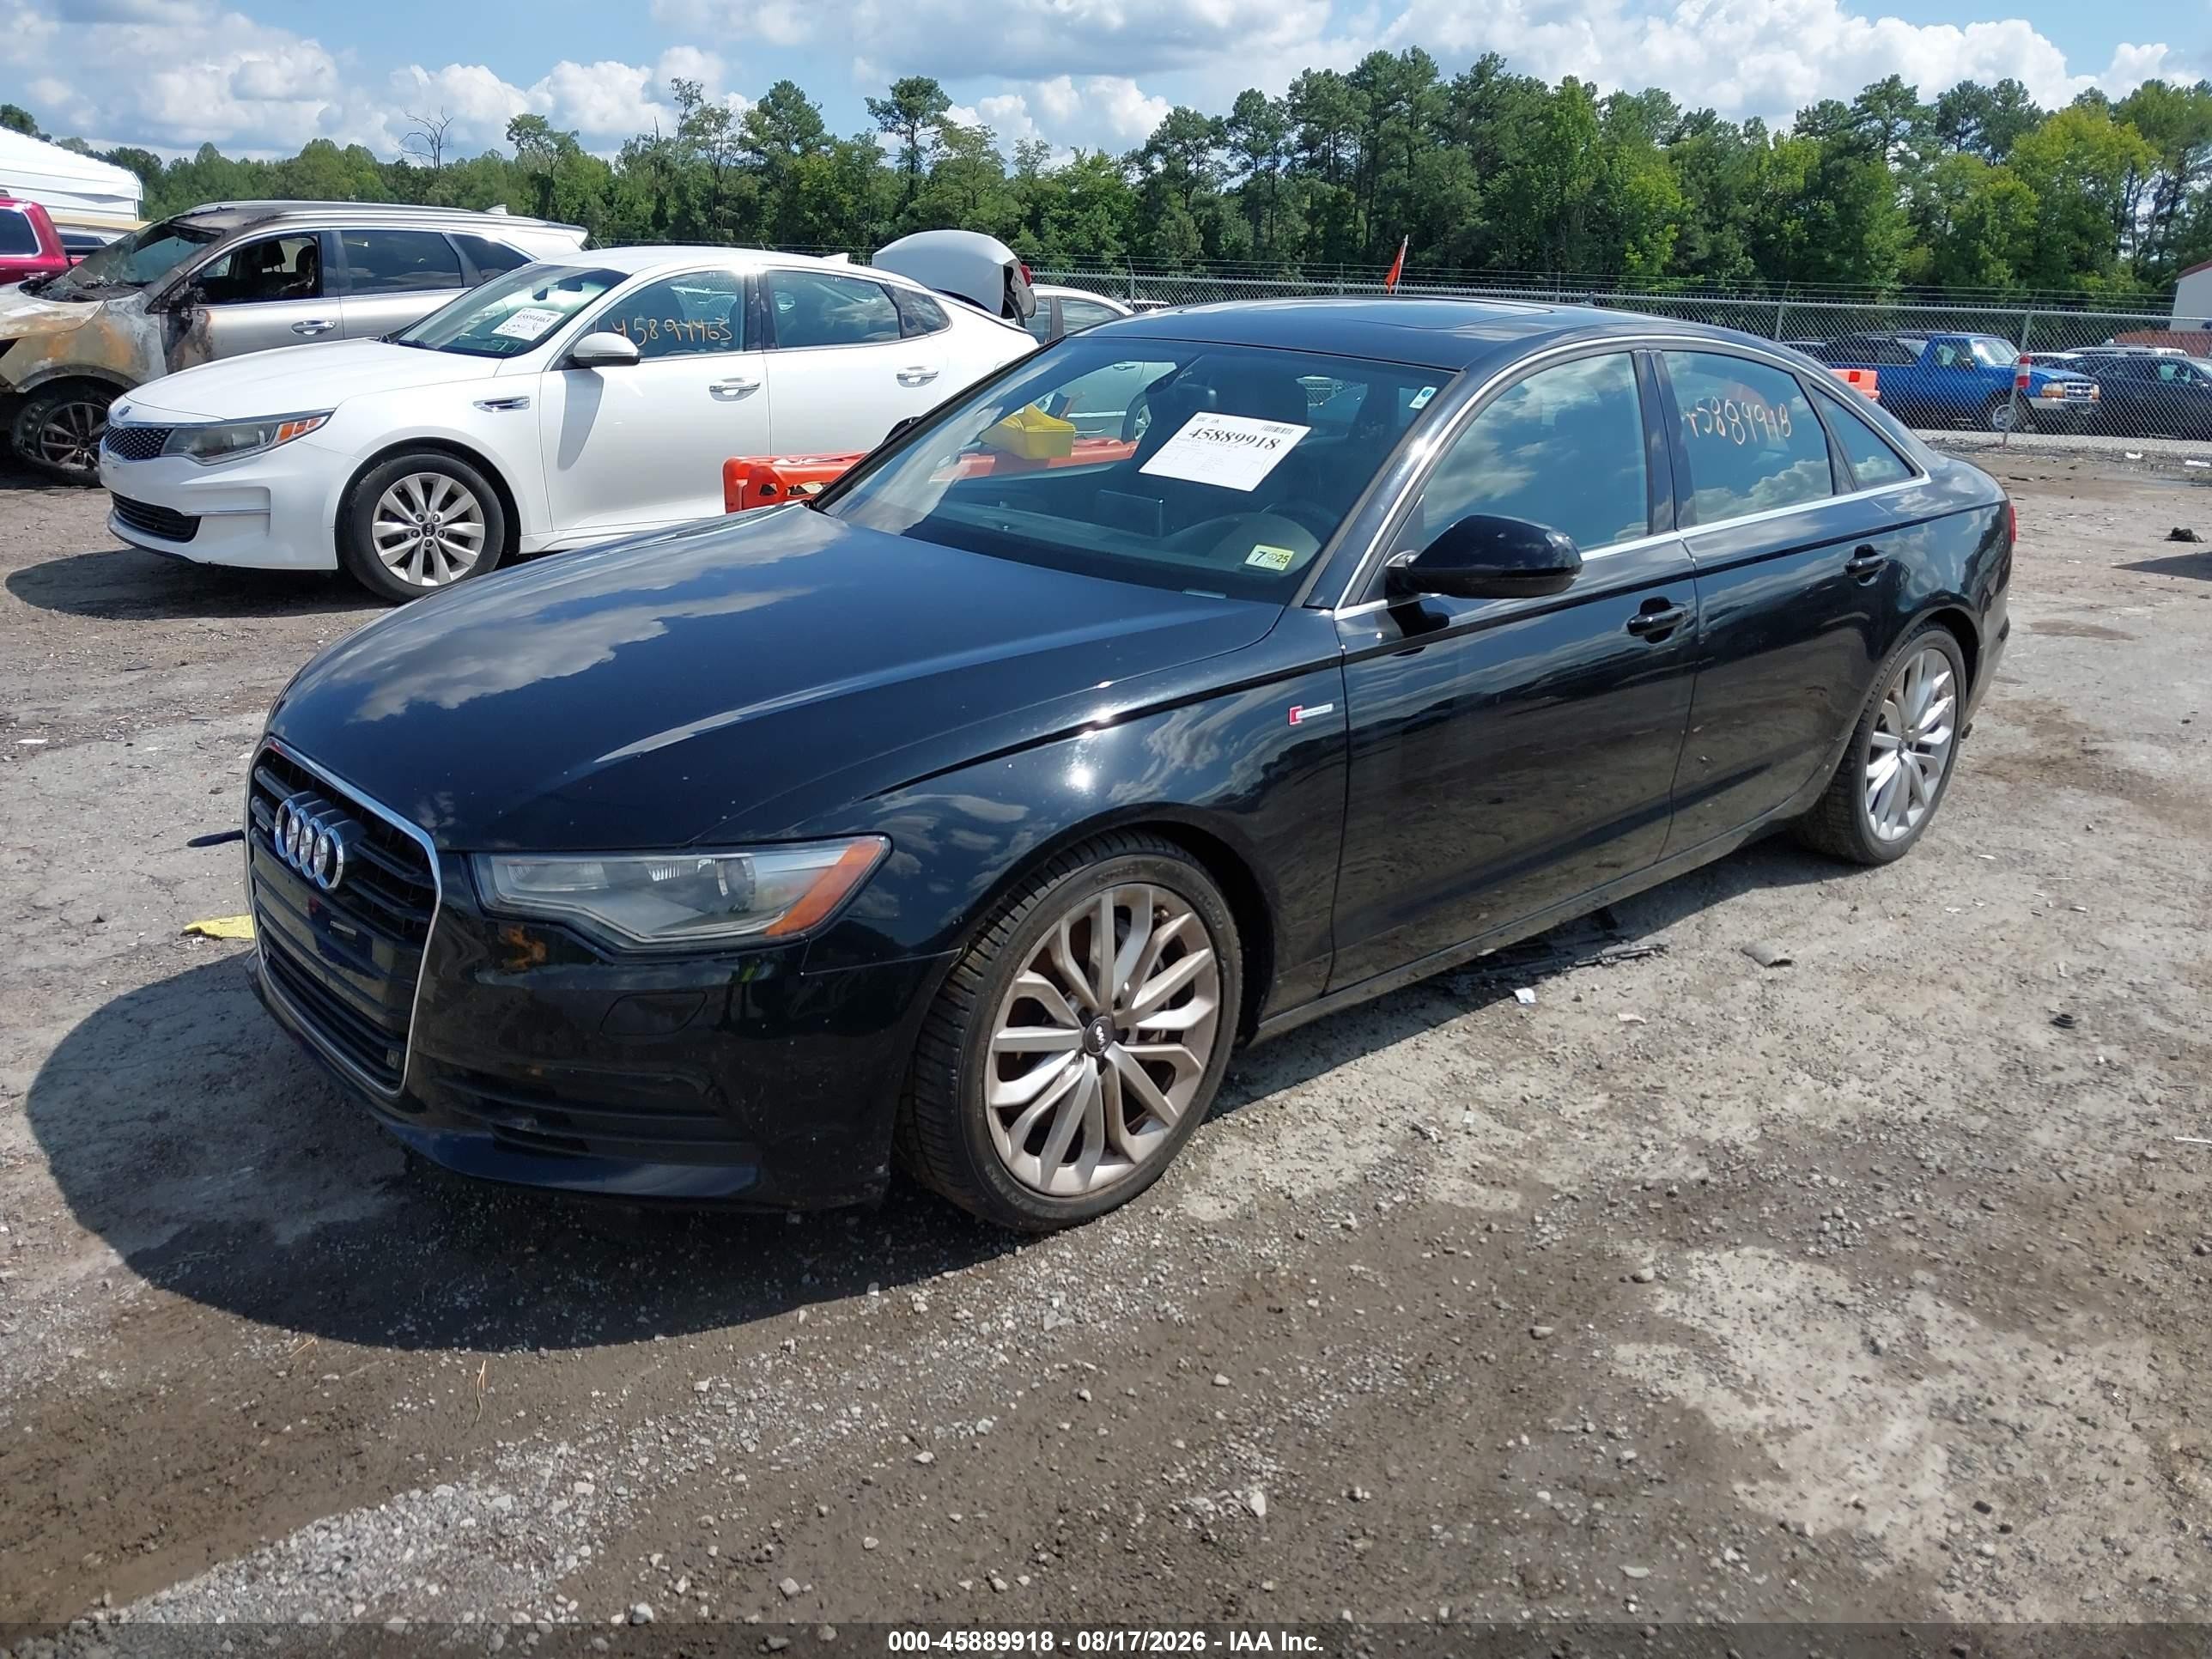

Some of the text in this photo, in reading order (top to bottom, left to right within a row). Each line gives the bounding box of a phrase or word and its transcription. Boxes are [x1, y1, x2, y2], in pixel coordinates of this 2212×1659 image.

[1188, 428, 1281, 451] 45889918
[1255, 550, 1290, 564] 7 25
